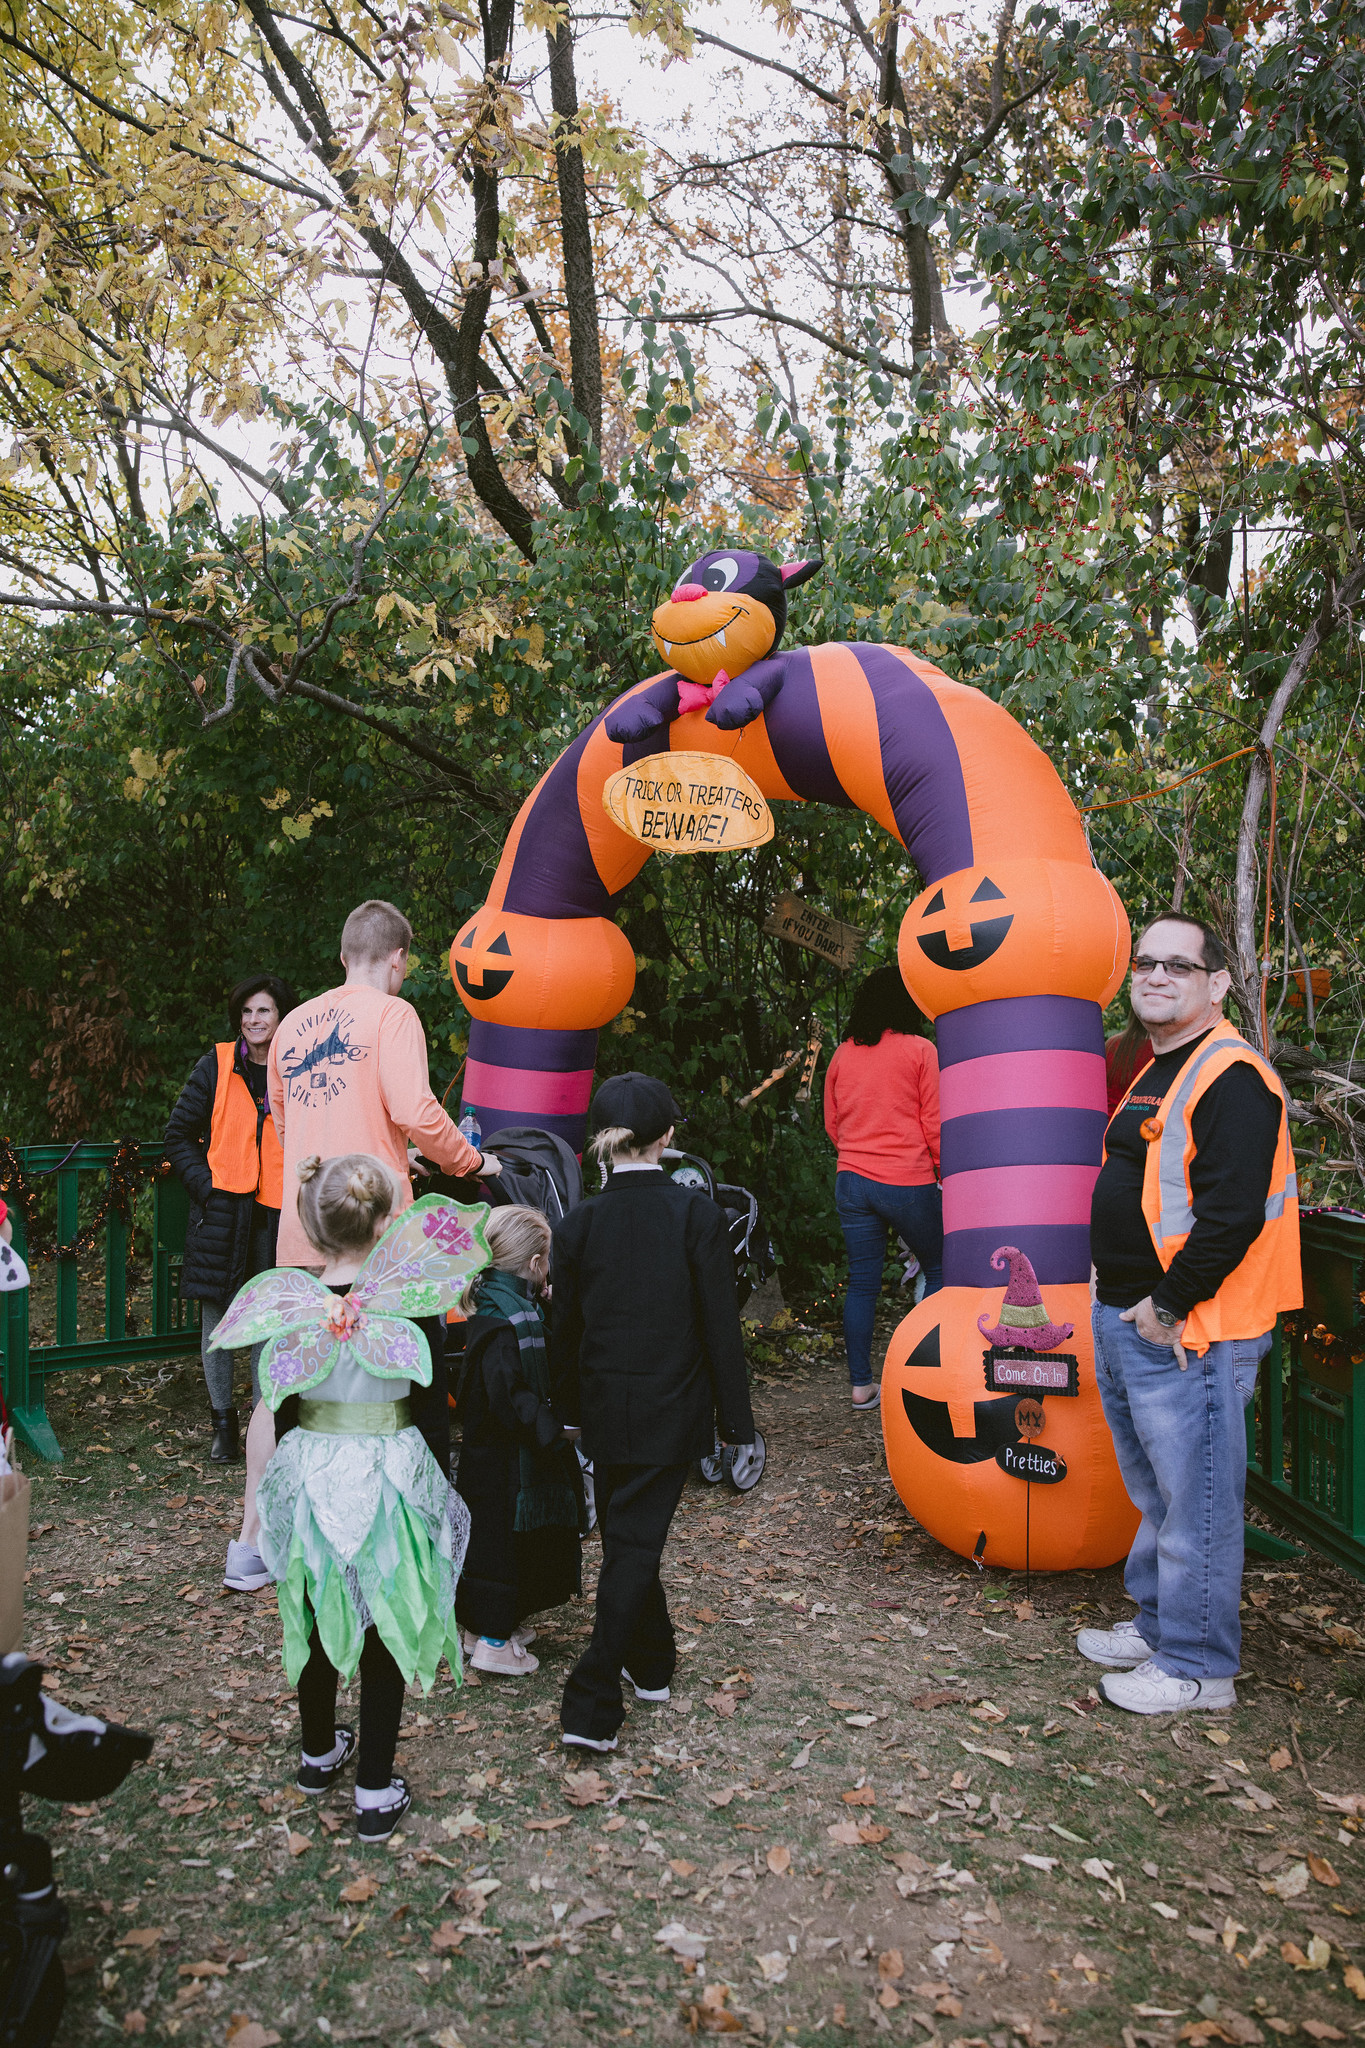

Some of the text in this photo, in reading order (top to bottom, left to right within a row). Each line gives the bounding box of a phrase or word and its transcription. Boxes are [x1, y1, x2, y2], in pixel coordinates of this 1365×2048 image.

[625, 777, 763, 821] TRICK OR TREATERS
[641, 810, 729, 845] BEWARE!
[793, 922, 814, 942] YOU
[997, 1365, 1063, 1384] Come On In
[1018, 1410, 1042, 1428] MY
[1005, 1447, 1057, 1476] Pretties
